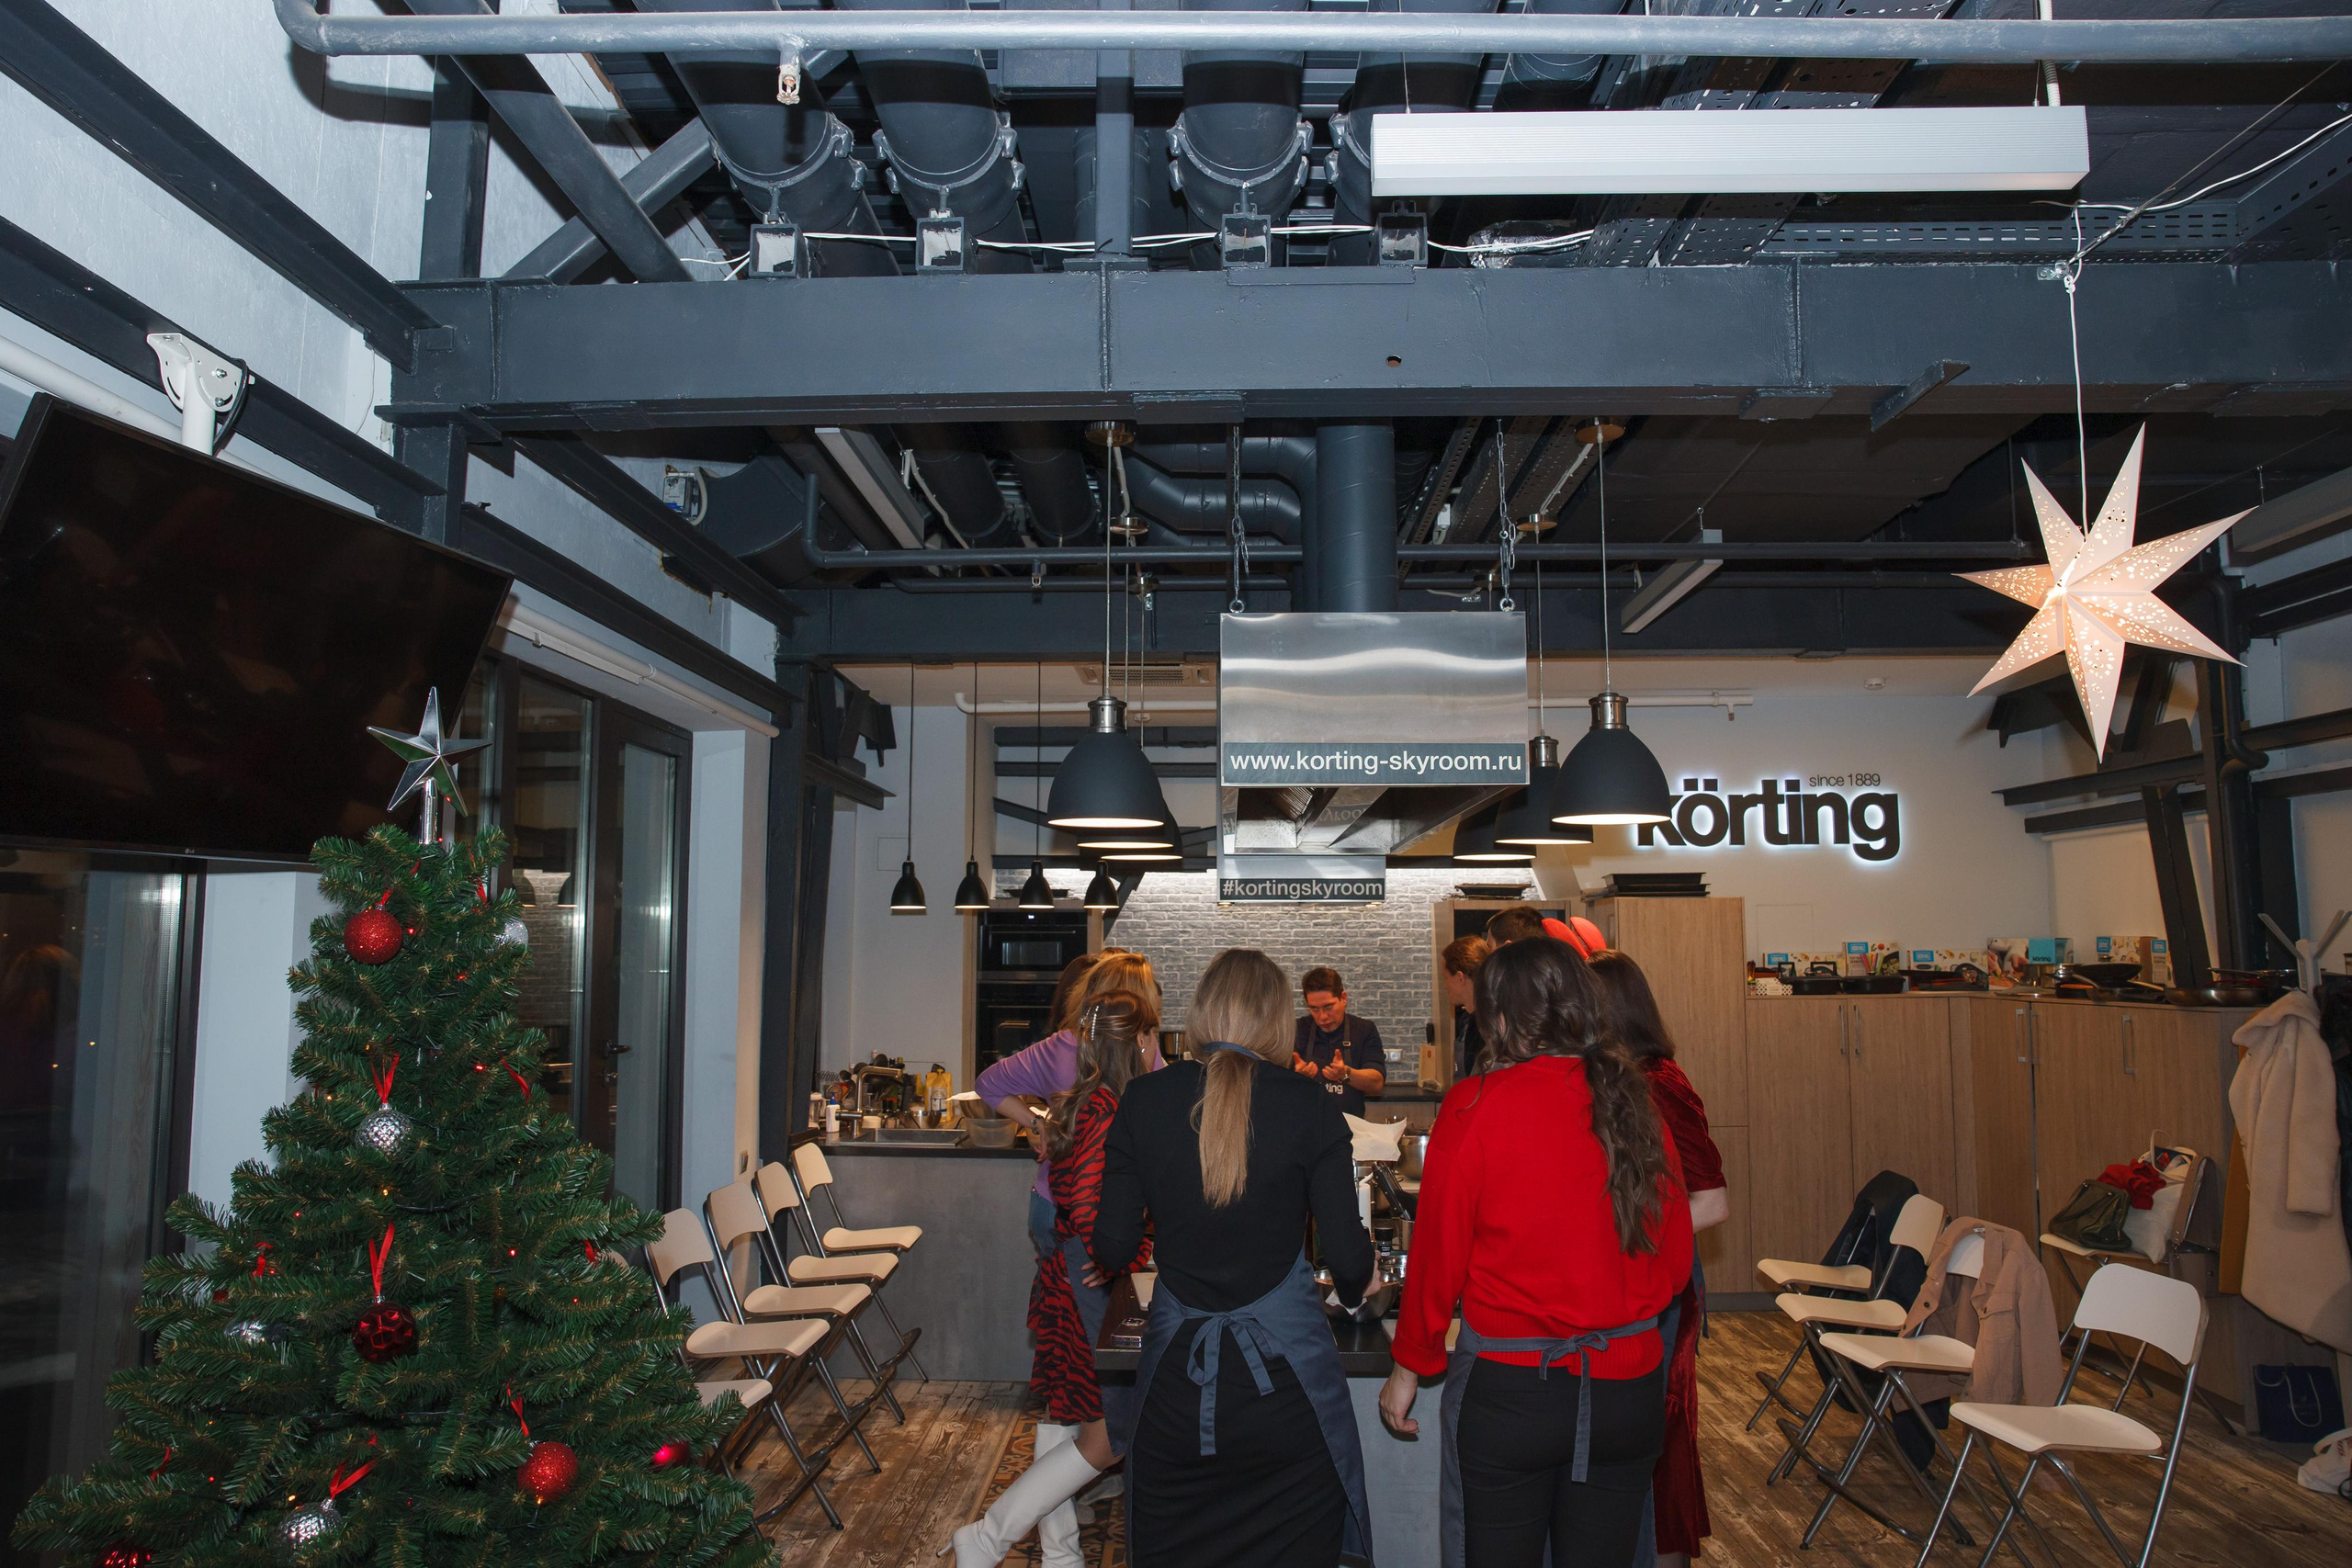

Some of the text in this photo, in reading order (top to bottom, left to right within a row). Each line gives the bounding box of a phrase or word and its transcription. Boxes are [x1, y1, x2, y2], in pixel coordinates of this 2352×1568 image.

[1230, 750, 1521, 774] www.korting-skyroom.ru
[1809, 773, 1881, 787] since 1889
[1223, 879, 1383, 898] #kortingskyroom
[1325, 1083, 1343, 1094] ting
